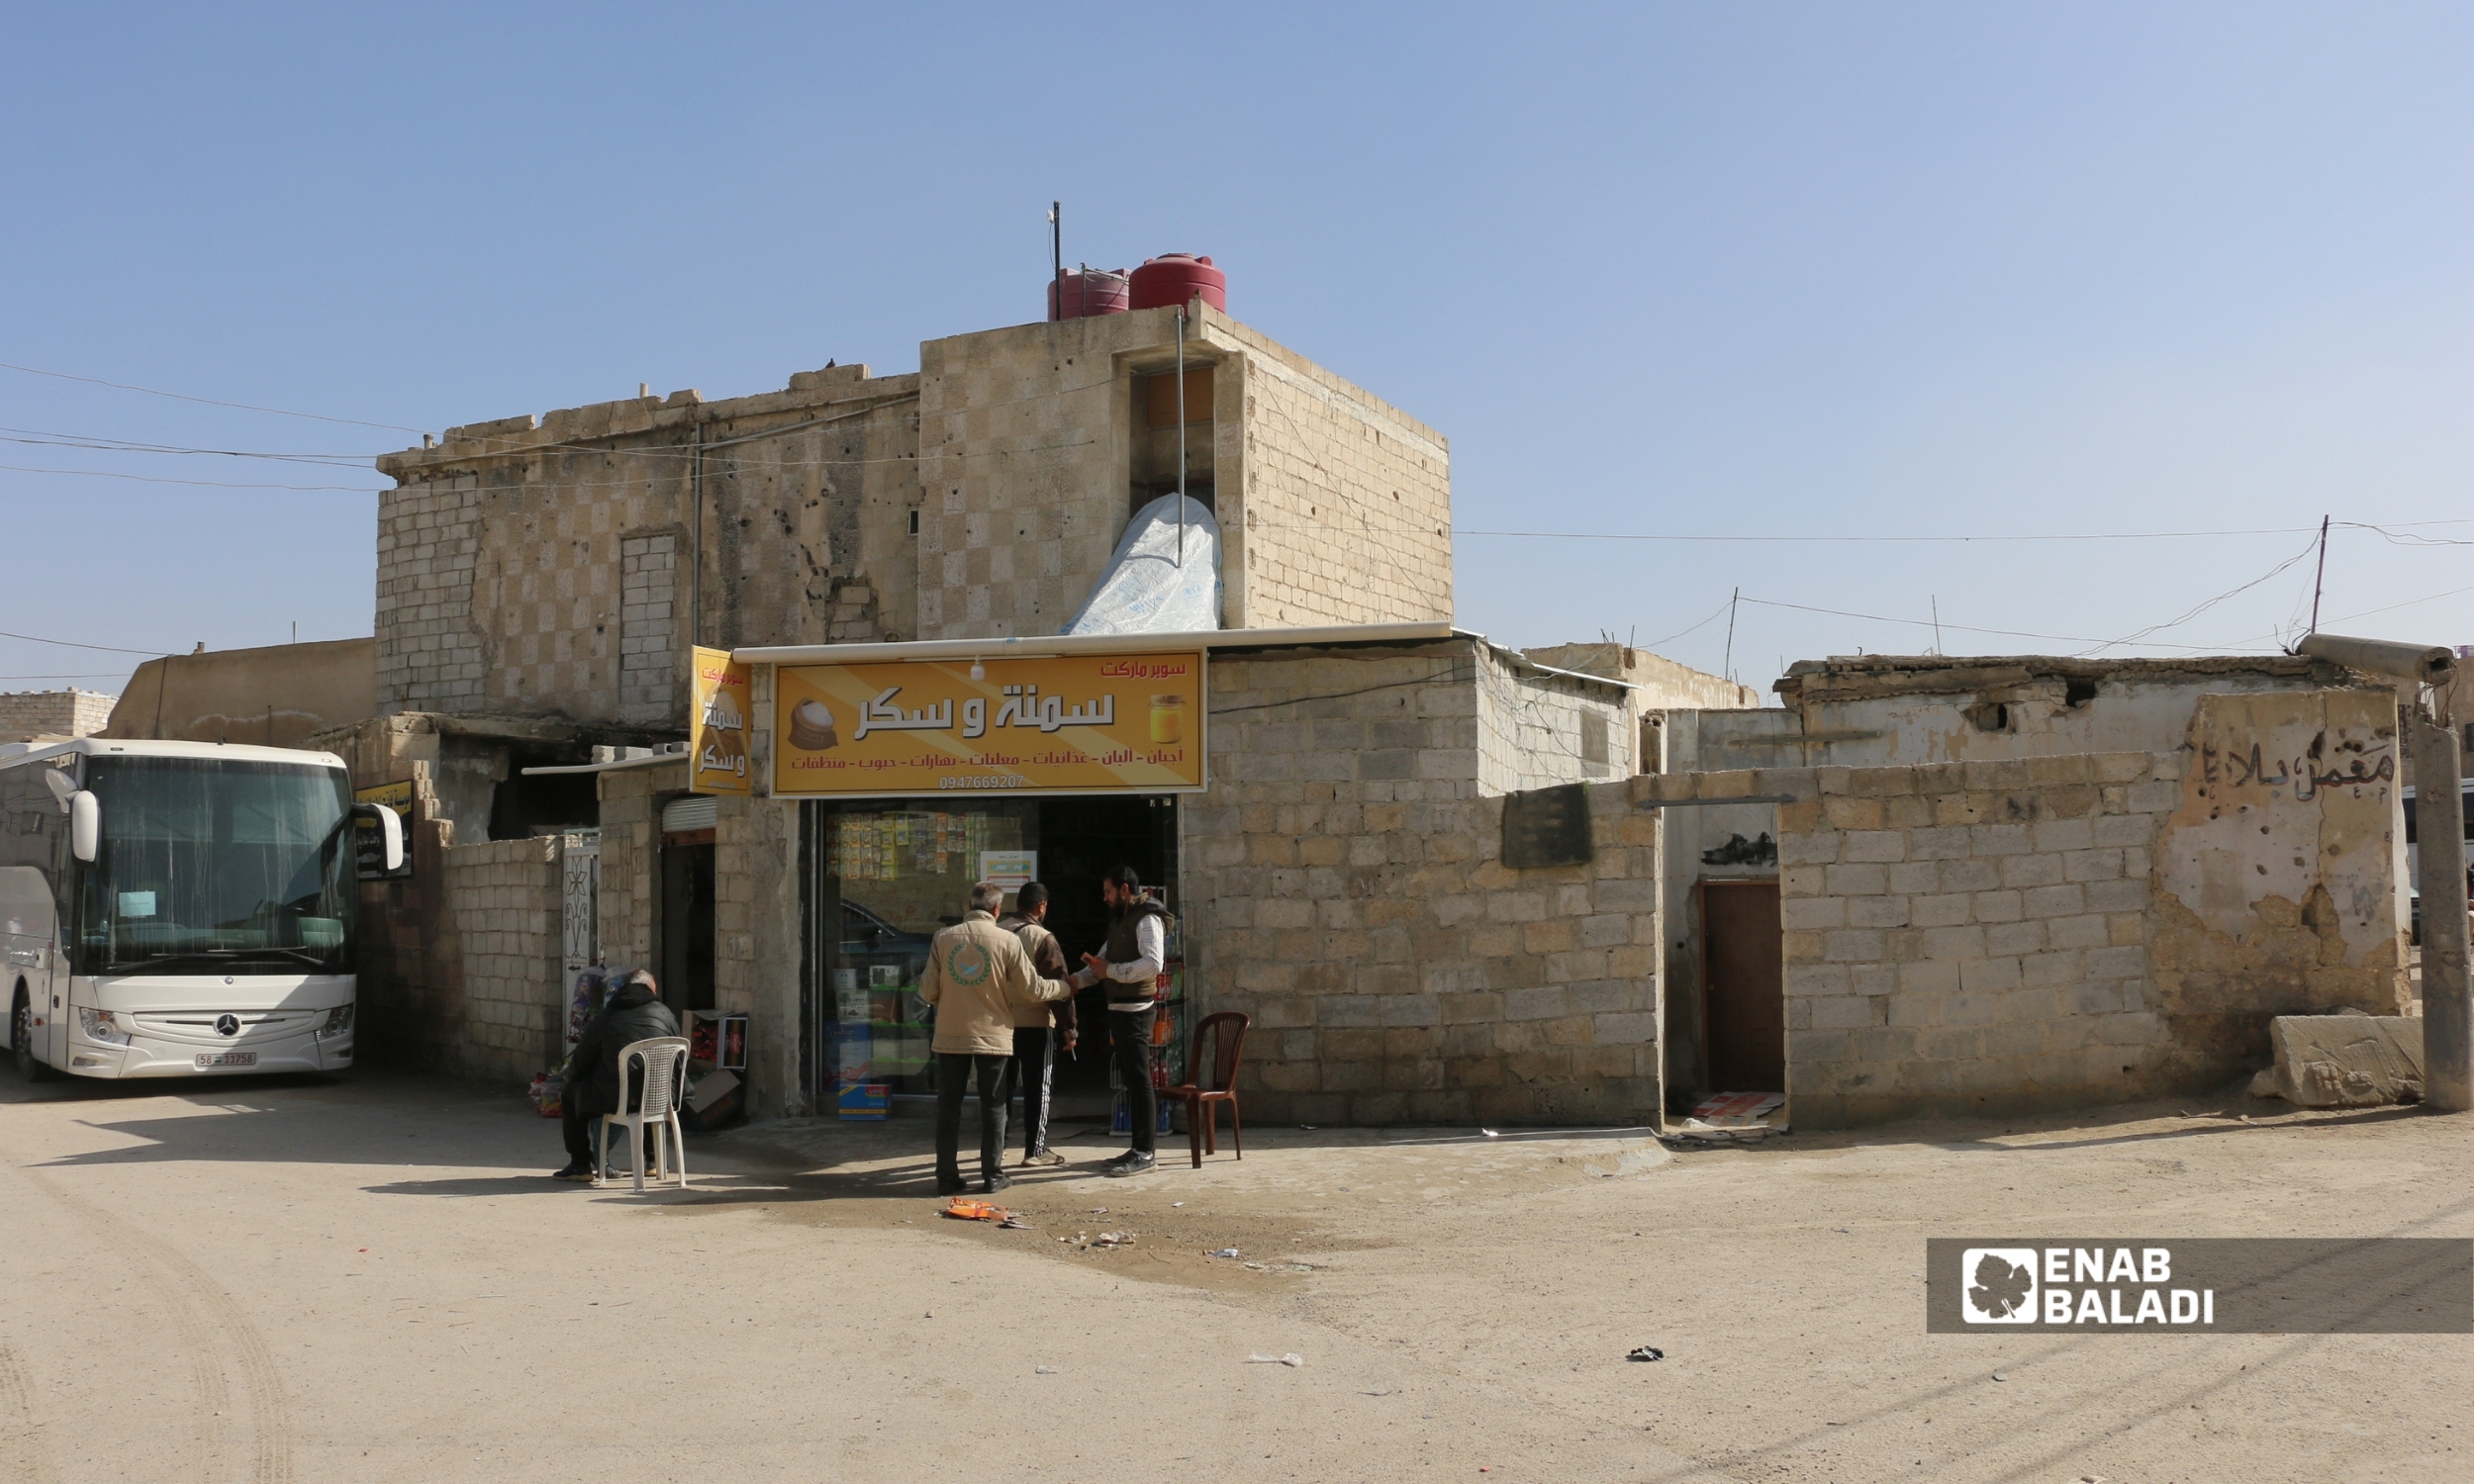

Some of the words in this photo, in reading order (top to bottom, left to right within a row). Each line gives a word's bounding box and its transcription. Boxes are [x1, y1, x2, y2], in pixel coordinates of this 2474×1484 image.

[702, 667, 726, 683] ماركت
[1100, 662, 1148, 680] ماركت
[1151, 662, 1187, 679] سوبر
[726, 674, 744, 686] سوبر
[702, 701, 743, 731] سمنة
[854, 687, 954, 740] سكر
[995, 685, 1115, 732] سمنة
[962, 697, 987, 738] و
[699, 744, 734, 775] سكر
[791, 756, 846, 769] منظفات
[858, 758, 897, 772] حبوب
[909, 754, 957, 770] بهارات
[969, 752, 1020, 769] معلبات
[1033, 751, 1089, 768] غذائيات
[1101, 747, 1133, 767] ألبان
[1147, 747, 1184, 766] أجبان
[939, 775, 1024, 789] 0947669207
[200, 1055, 212, 1065] 58
[224, 1054, 253, 1065] 11758
